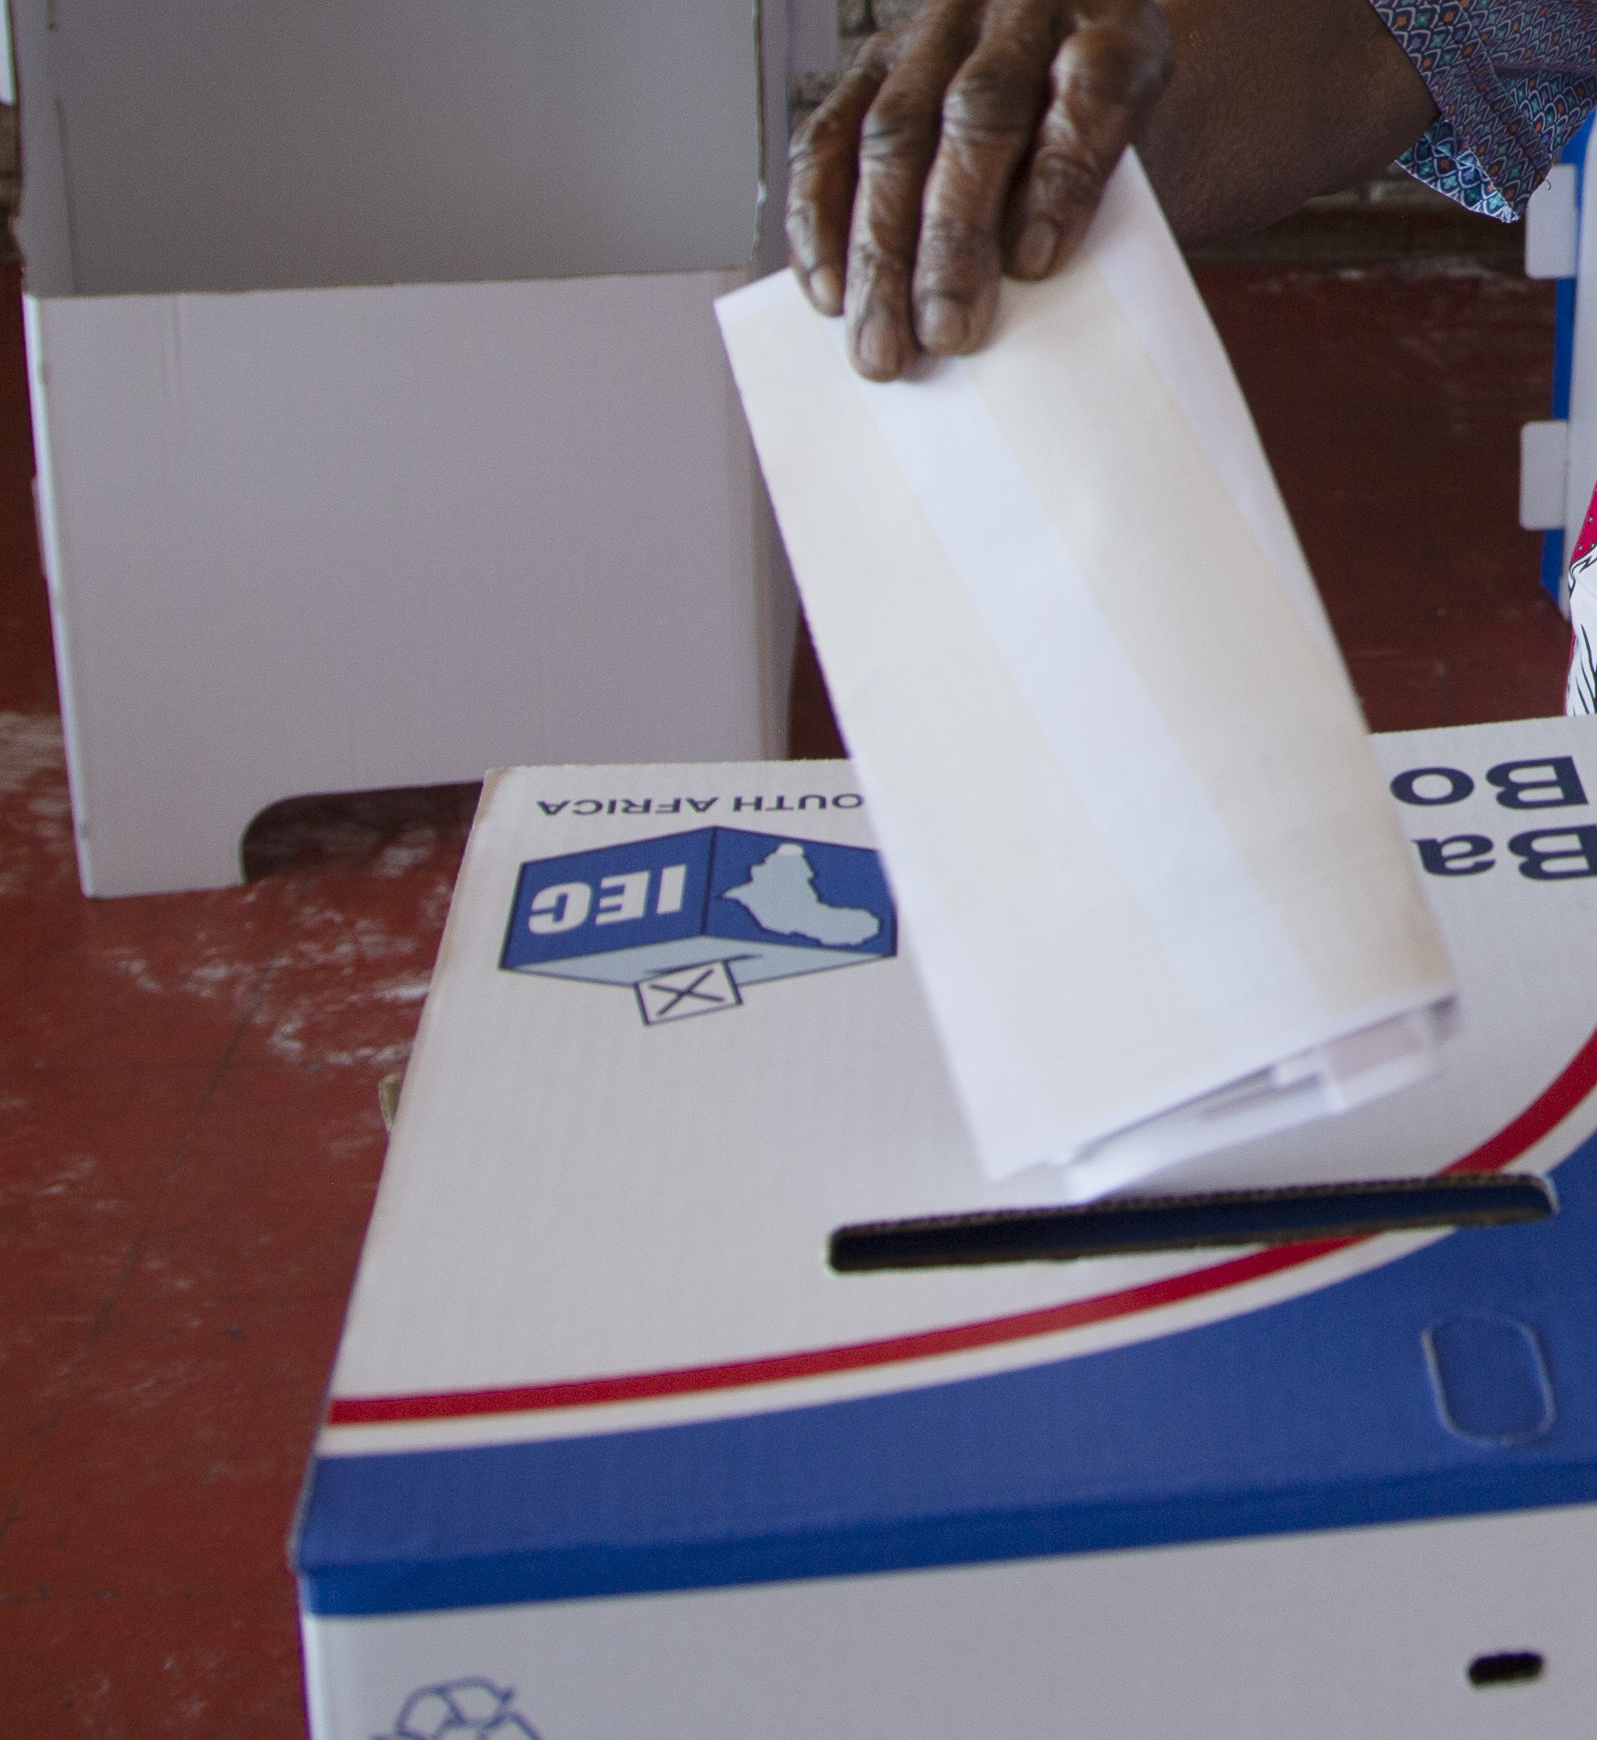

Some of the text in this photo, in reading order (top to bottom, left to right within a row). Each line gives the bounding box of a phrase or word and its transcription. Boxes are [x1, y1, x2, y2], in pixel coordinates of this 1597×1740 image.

[536, 793, 866, 816] OUTH AFRICA
[1389, 755, 1590, 810] Bo
[527, 863, 687, 936] IEC
